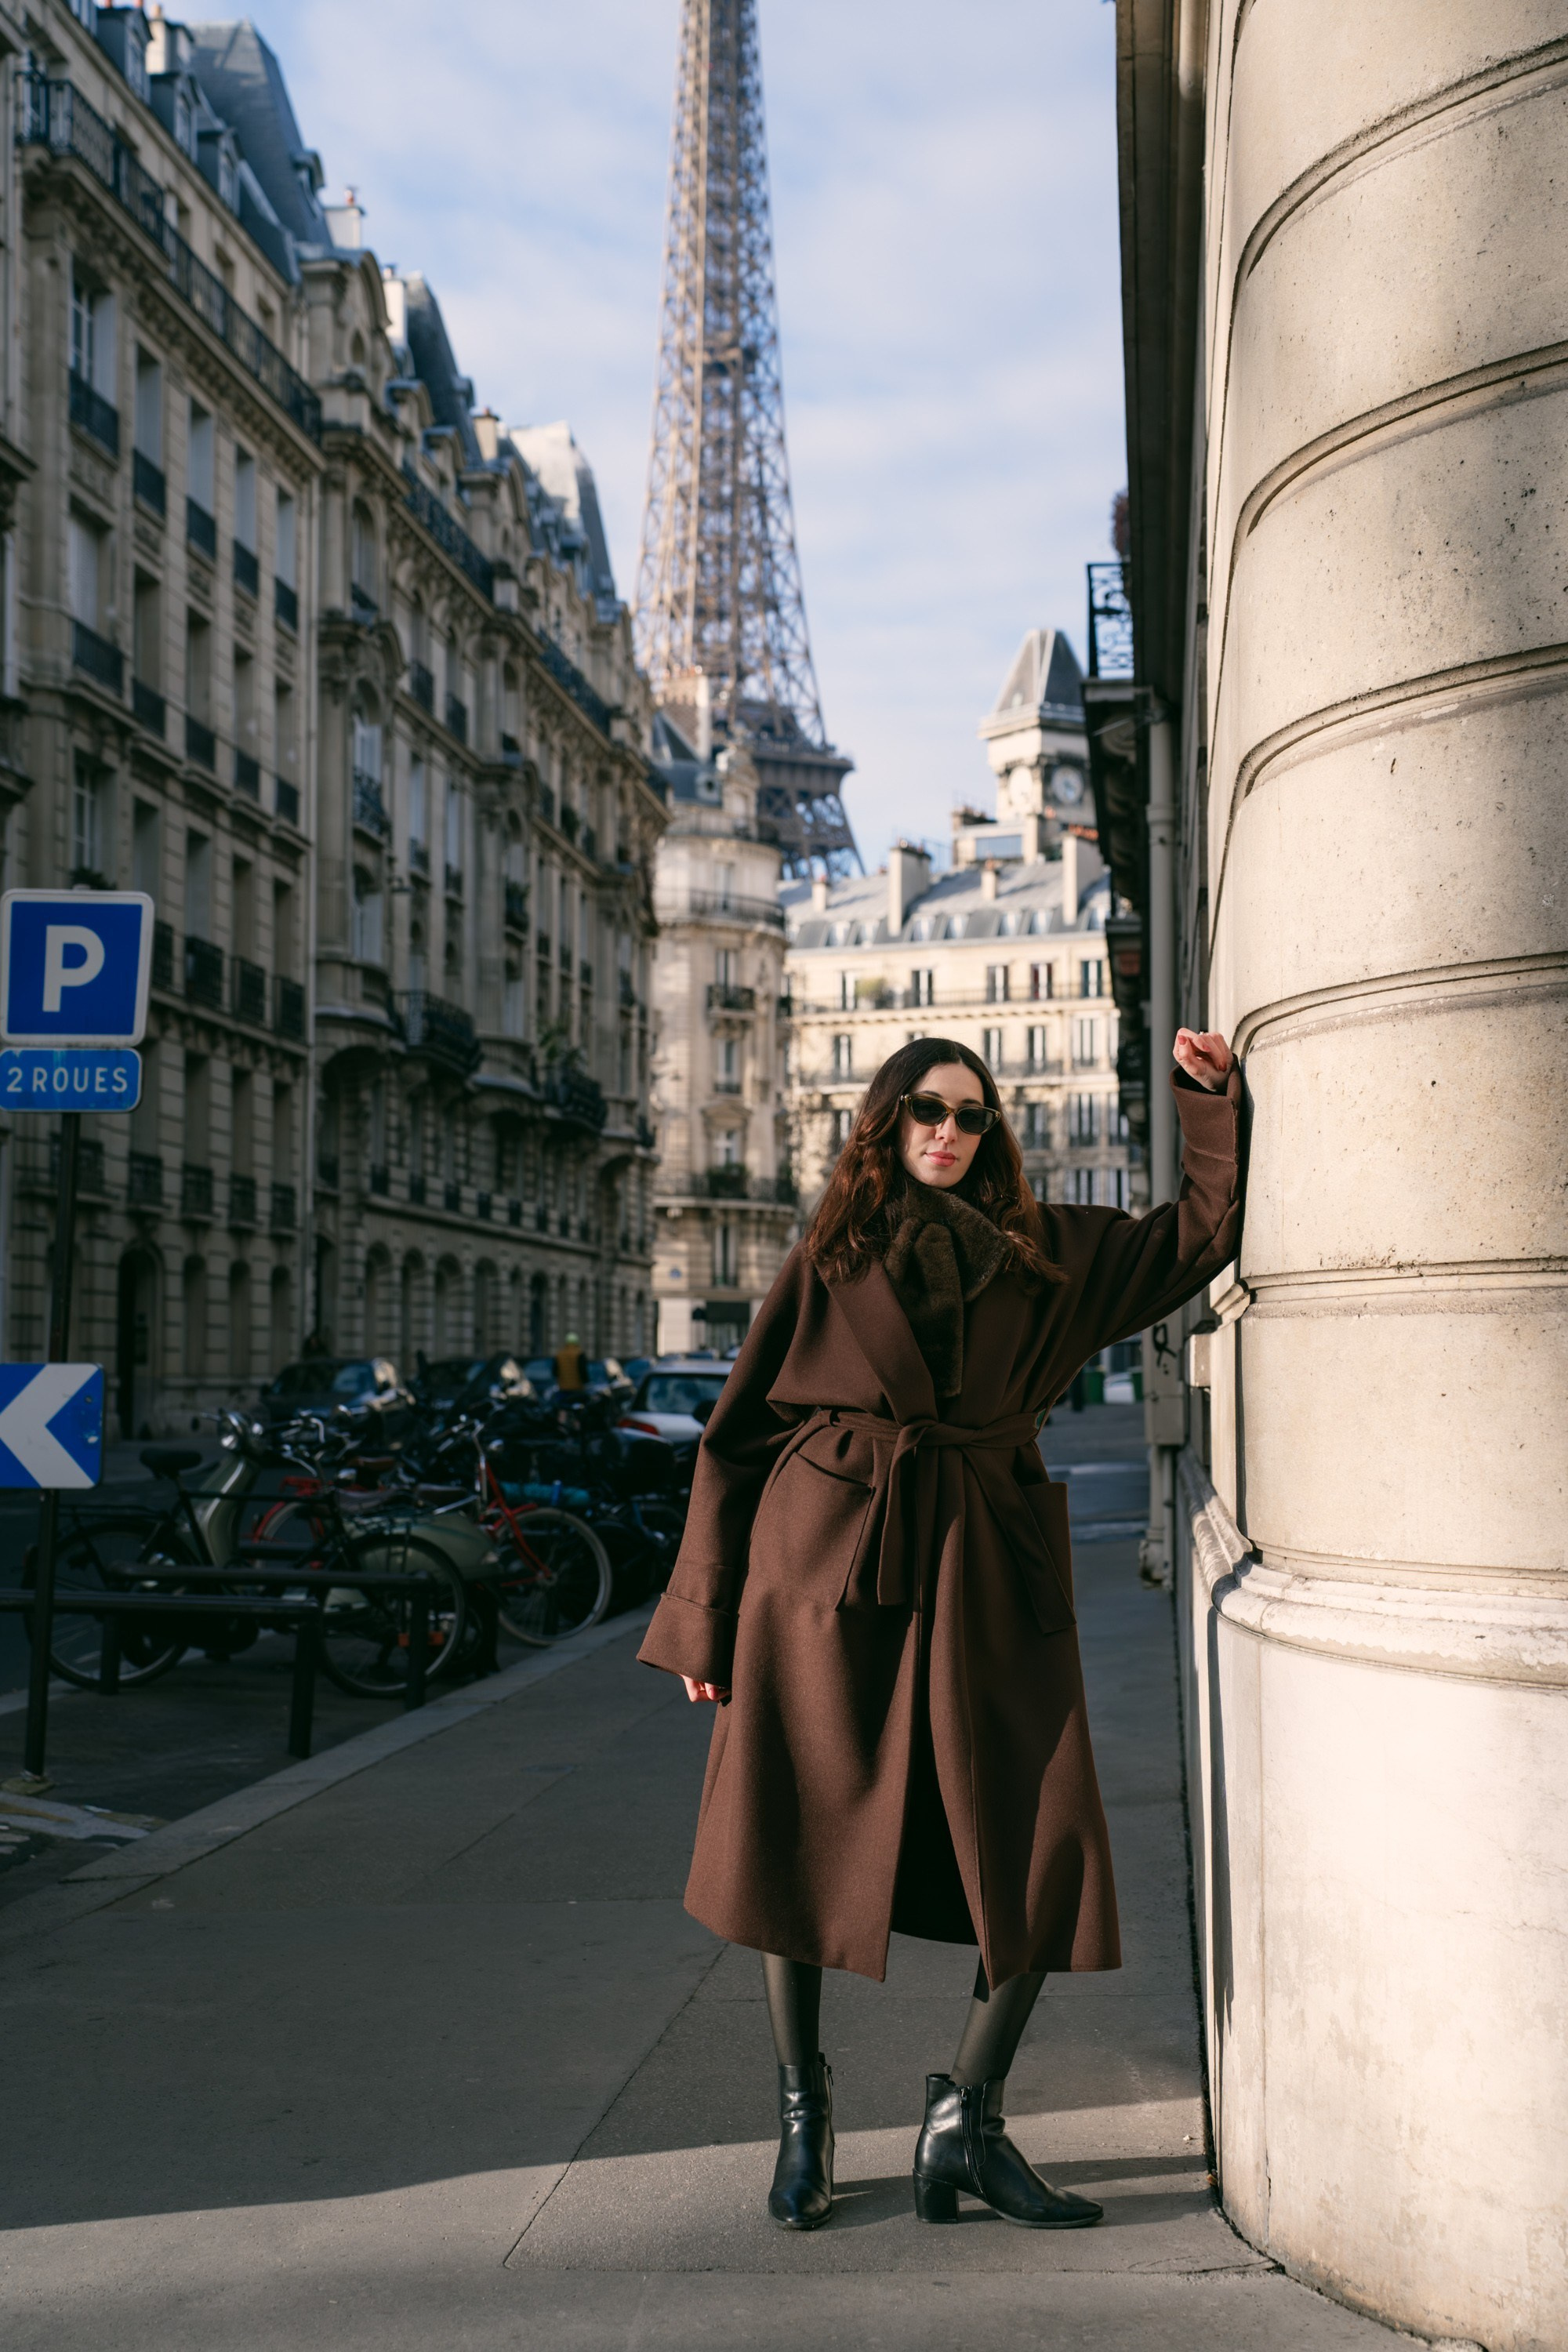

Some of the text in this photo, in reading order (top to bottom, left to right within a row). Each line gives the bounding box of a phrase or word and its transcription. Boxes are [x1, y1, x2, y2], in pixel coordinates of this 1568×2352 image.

[42, 924, 105, 1012] P
[6, 1067, 128, 1092] 2 ROUES
